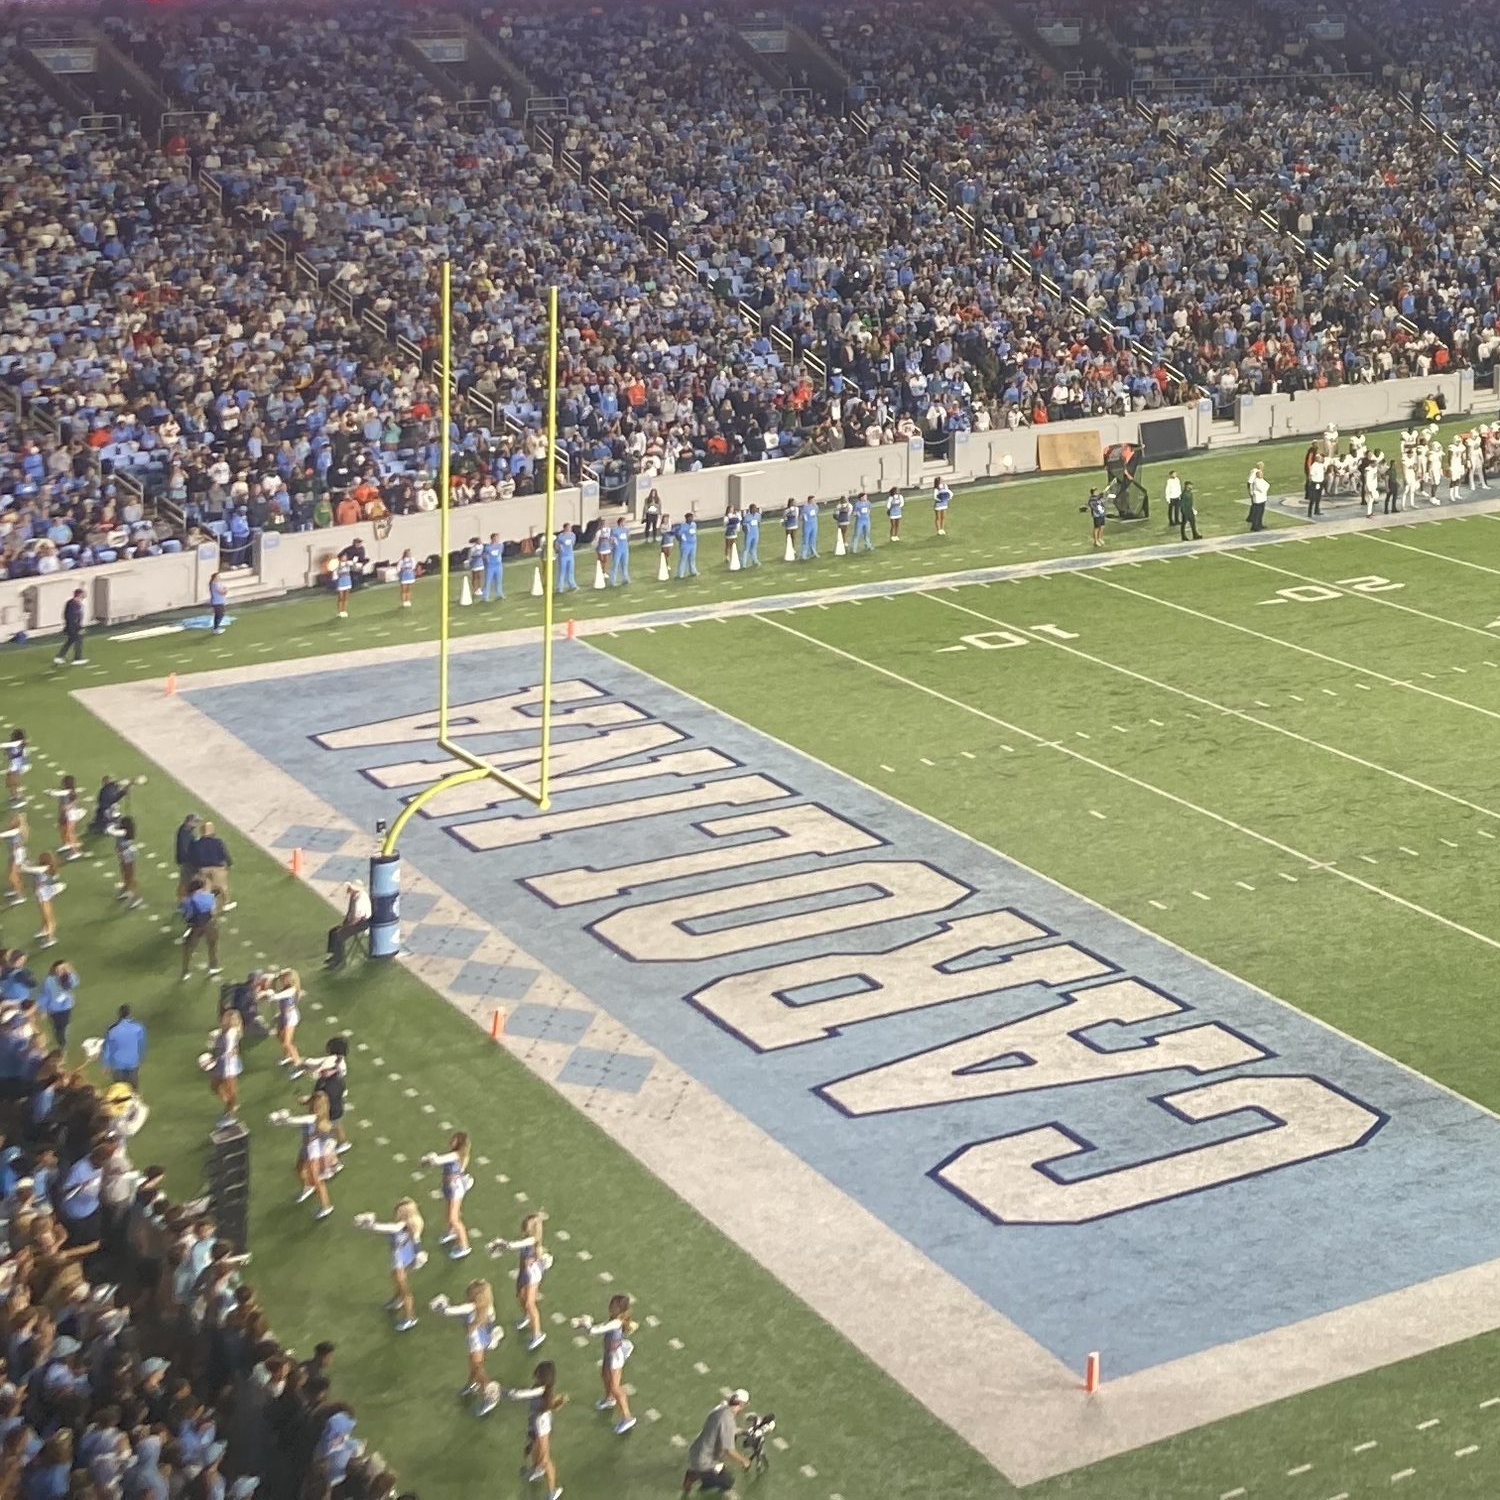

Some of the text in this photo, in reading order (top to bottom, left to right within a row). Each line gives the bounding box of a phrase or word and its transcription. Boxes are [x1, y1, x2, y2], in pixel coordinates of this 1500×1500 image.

[1275, 575, 1405, 603] 20
[960, 624, 1080, 650] 10
[307, 677, 1390, 1227] CAROLINA
